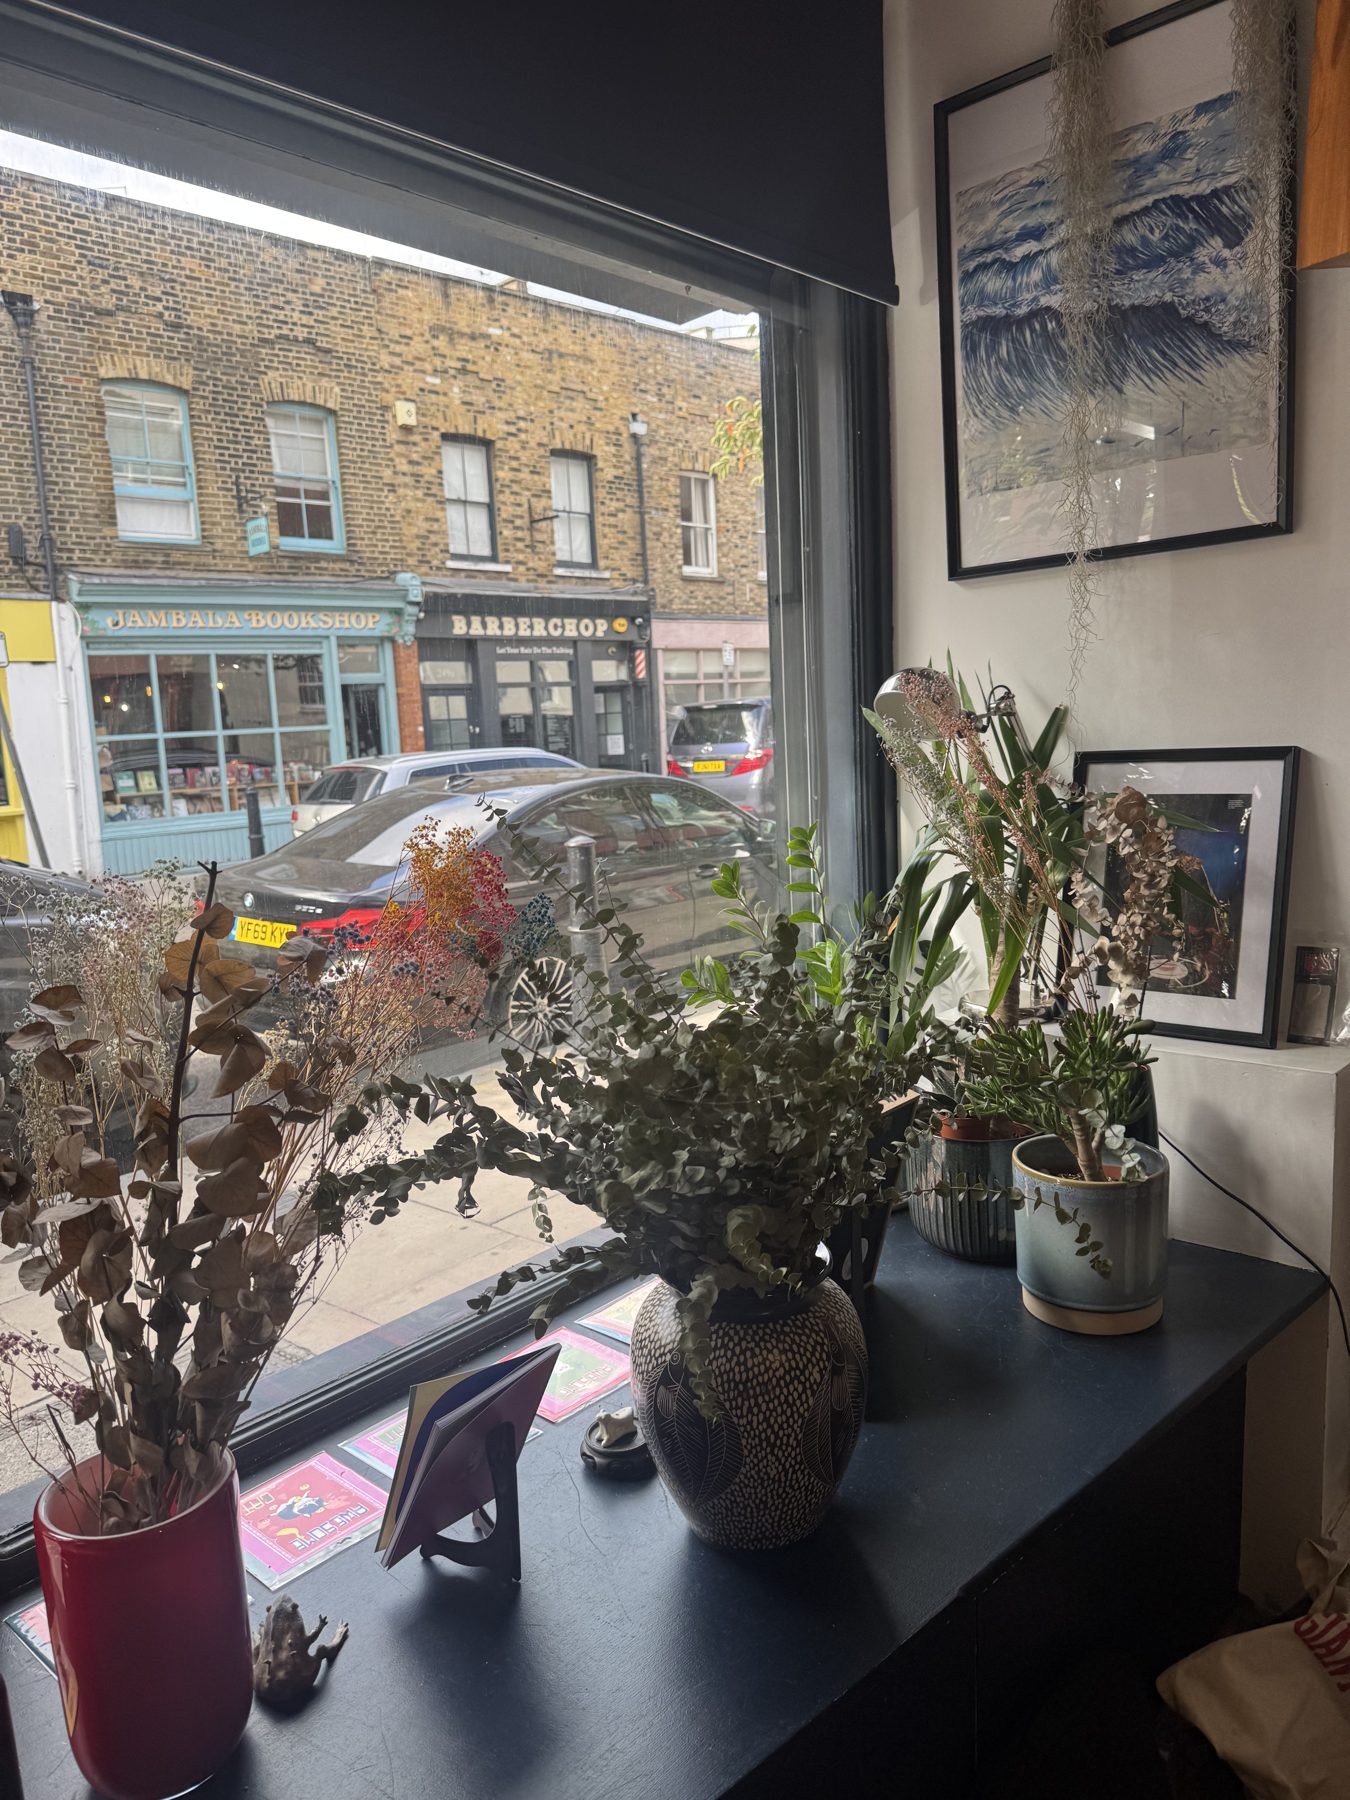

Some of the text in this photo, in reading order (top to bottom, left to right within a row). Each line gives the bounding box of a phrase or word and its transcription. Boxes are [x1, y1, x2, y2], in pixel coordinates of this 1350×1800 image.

[106, 609, 381, 630] JAMBALA BOOKSHOP
[451, 614, 609, 637] BARBERCHOP
[240, 920, 295, 943] YF69 KY
[240, 1491, 275, 1516] CAT
[288, 1503, 369, 1551] AWESOME
